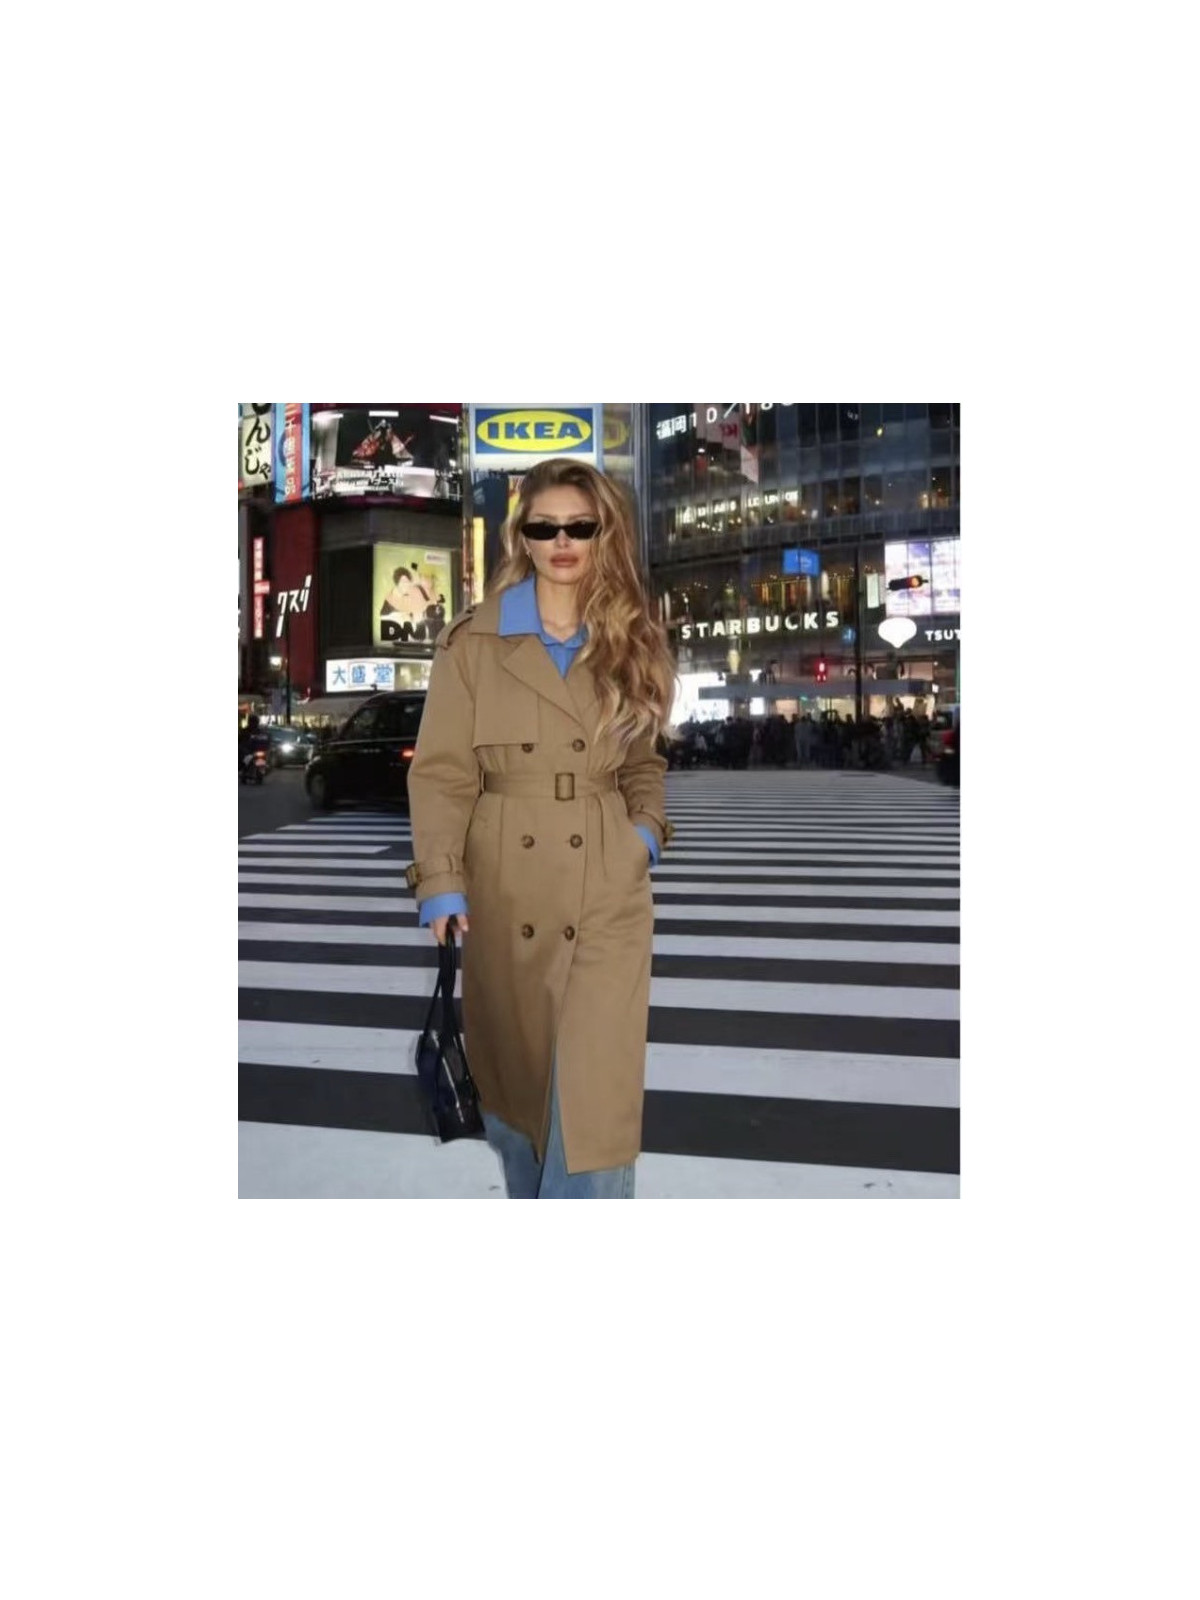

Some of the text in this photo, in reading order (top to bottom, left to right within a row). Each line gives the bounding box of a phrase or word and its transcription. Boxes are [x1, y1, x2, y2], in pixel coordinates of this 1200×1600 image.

[487, 421, 583, 440] IKEA
[681, 610, 839, 640] STARBUCKS
[332, 663, 393, 685] 大盛堂
